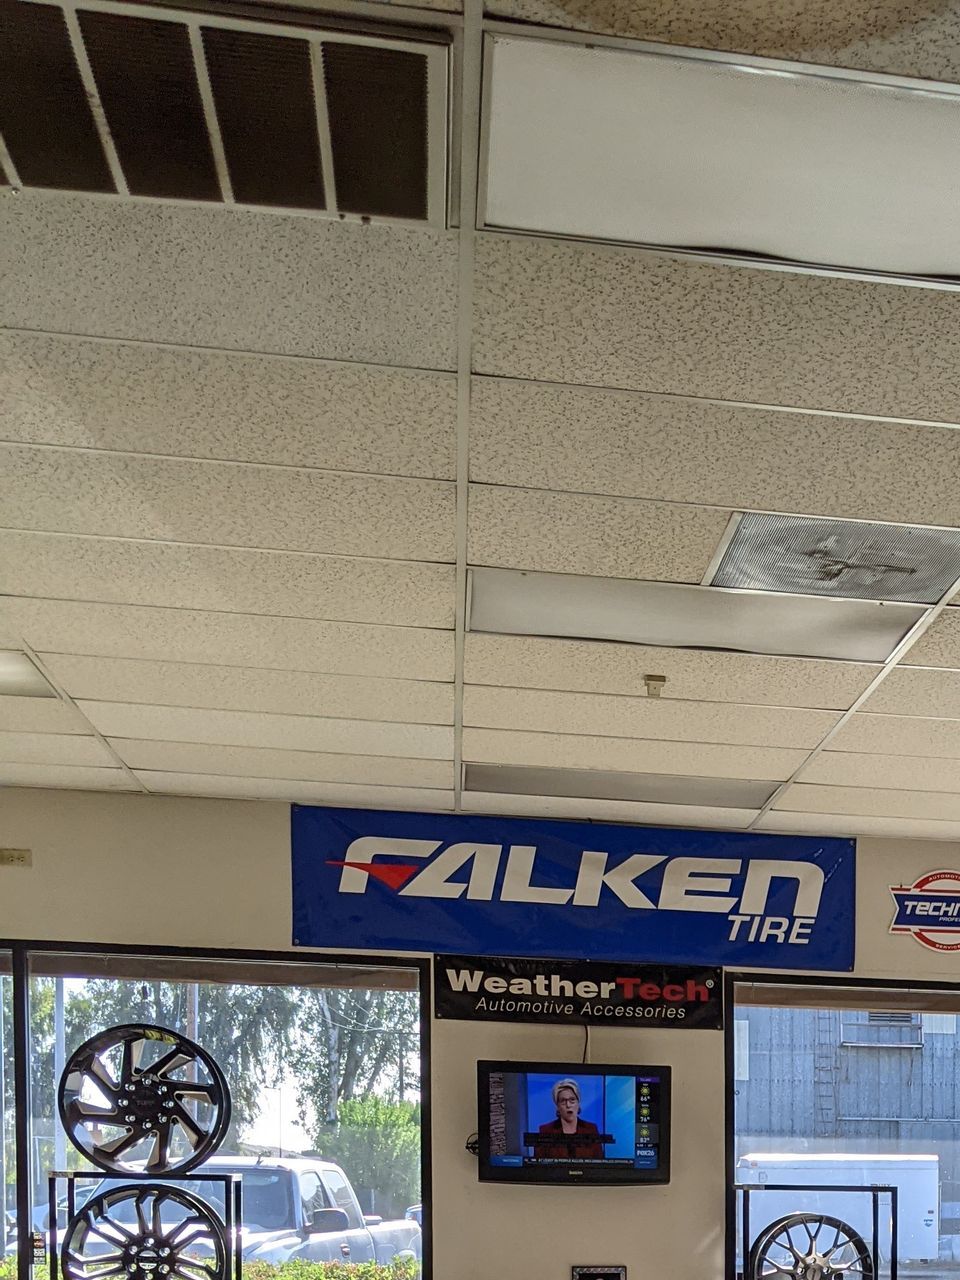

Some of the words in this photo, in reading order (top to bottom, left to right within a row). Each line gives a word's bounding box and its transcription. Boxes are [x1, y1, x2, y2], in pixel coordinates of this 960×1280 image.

[338, 835, 825, 918] FALKEN
[727, 914, 816, 945] TIRE
[475, 997, 574, 1015] Automotive
[580, 1001, 686, 1019] Accessories
